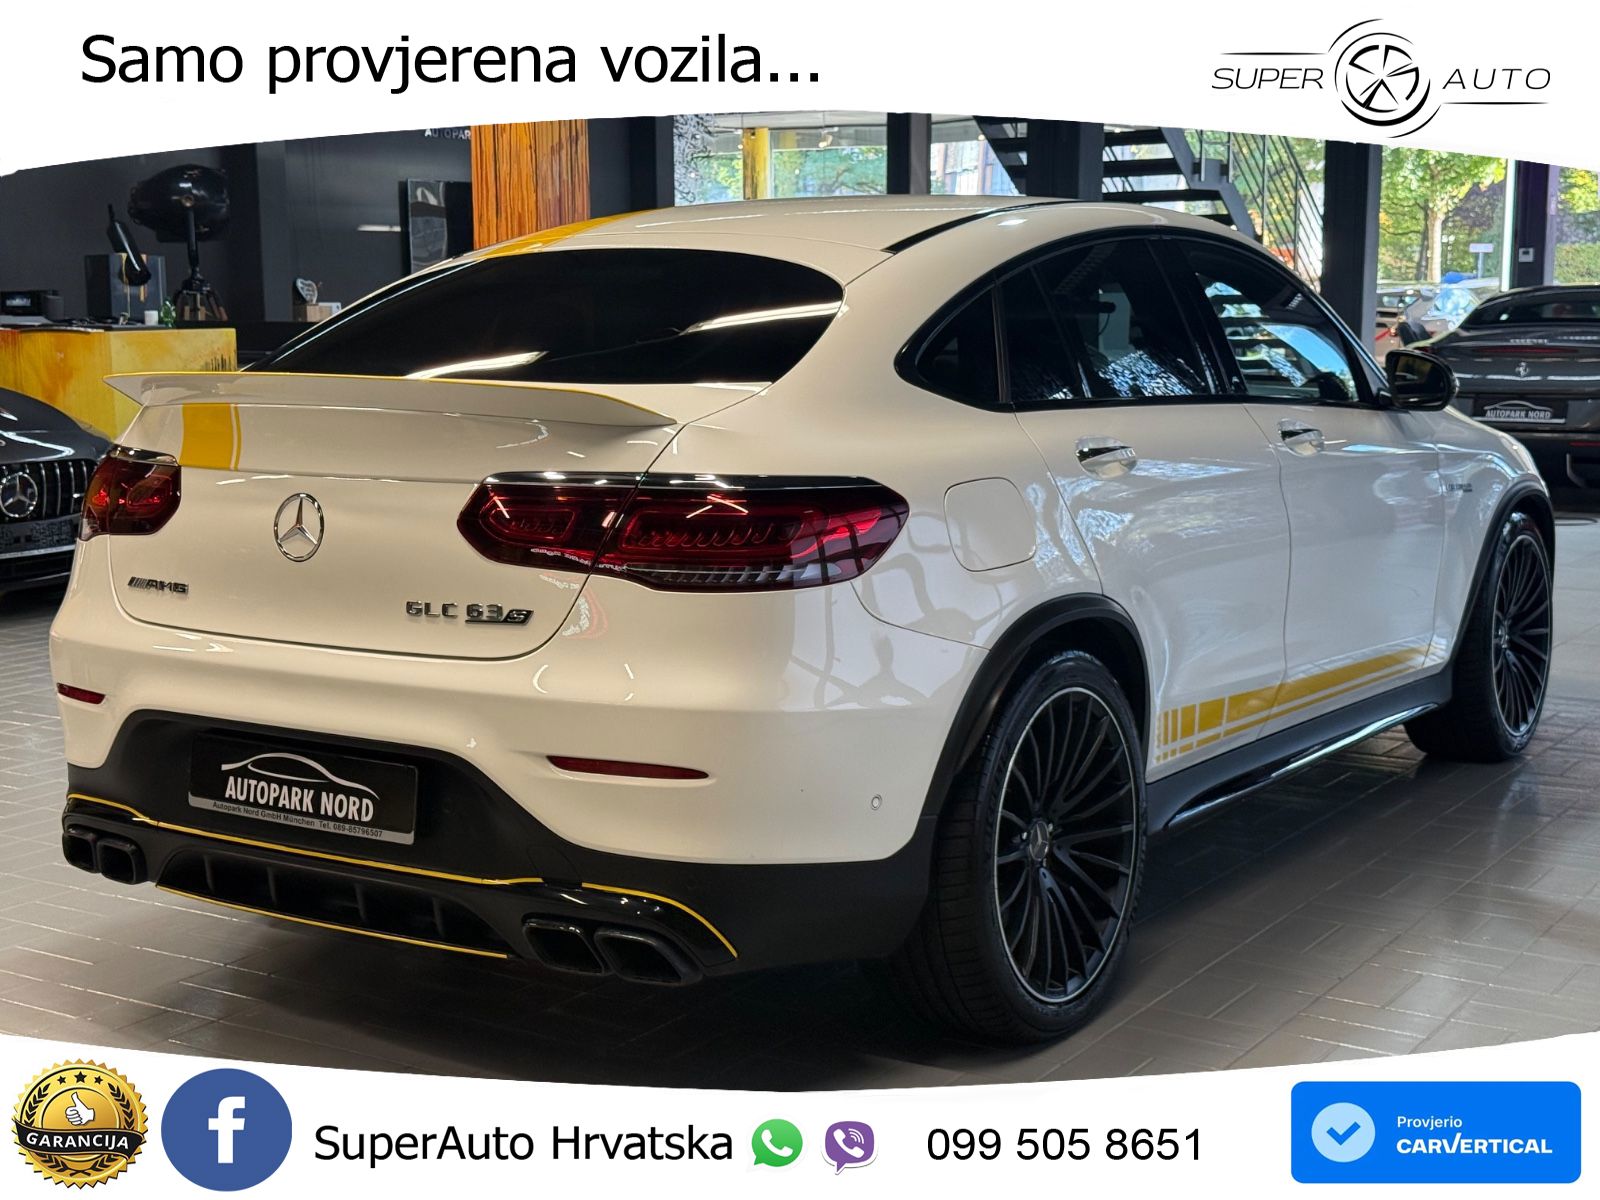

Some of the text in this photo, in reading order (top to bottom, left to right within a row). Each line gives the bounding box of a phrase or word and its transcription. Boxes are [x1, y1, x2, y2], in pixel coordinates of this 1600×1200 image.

[1485, 410, 1552, 419] AUTOPARK NORD
[406, 600, 459, 619] GLC
[225, 776, 374, 822] AUTOPARK NORD
[212, 801, 242, 813] Autopark
[243, 806, 259, 817] Nord
[260, 810, 282, 821] GmbH
[282, 814, 315, 827] München
[318, 820, 332, 830] Tel.
